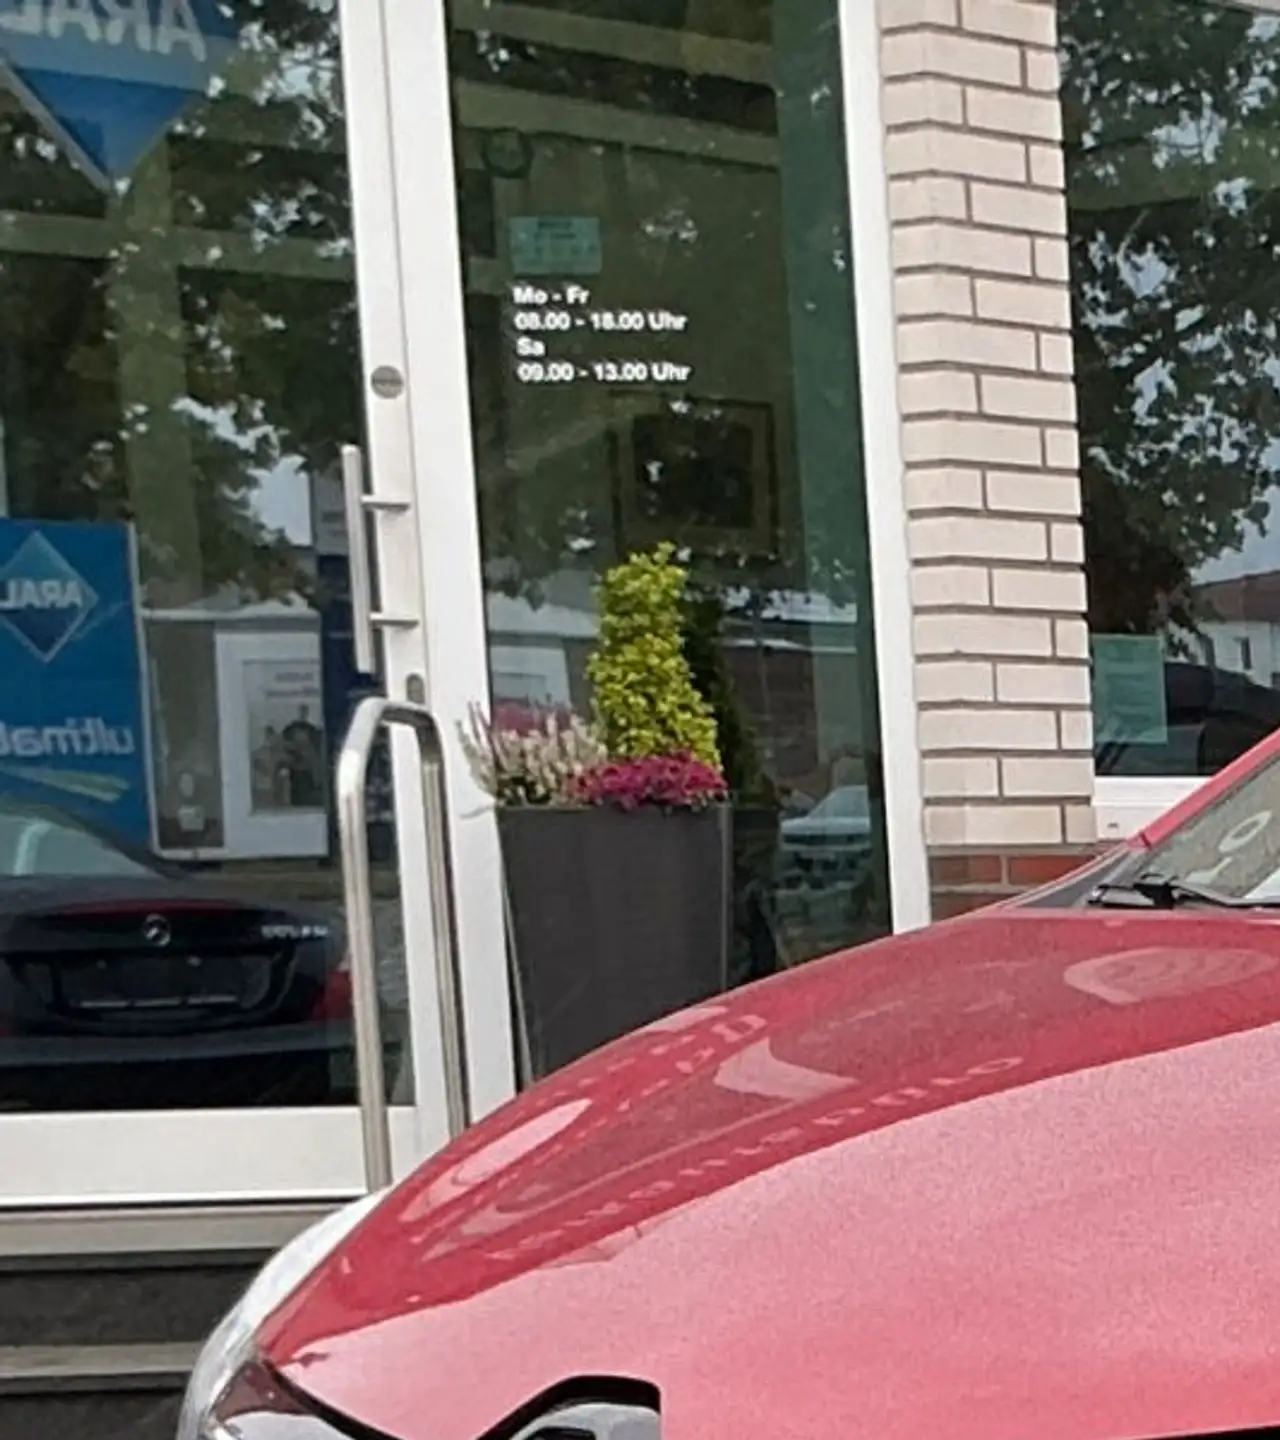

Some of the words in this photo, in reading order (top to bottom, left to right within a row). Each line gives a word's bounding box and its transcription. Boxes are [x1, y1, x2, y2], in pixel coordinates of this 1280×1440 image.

[512, 285, 548, 304] Mo
[566, 285, 590, 304] Fr
[514, 311, 571, 331] 08.00
[590, 311, 645, 331] 18.00
[648, 311, 688, 331] Uhr
[516, 336, 546, 356] Sa
[517, 362, 575, 382] 09.00
[593, 362, 648, 381] 13.00
[651, 361, 691, 381] Uhr
